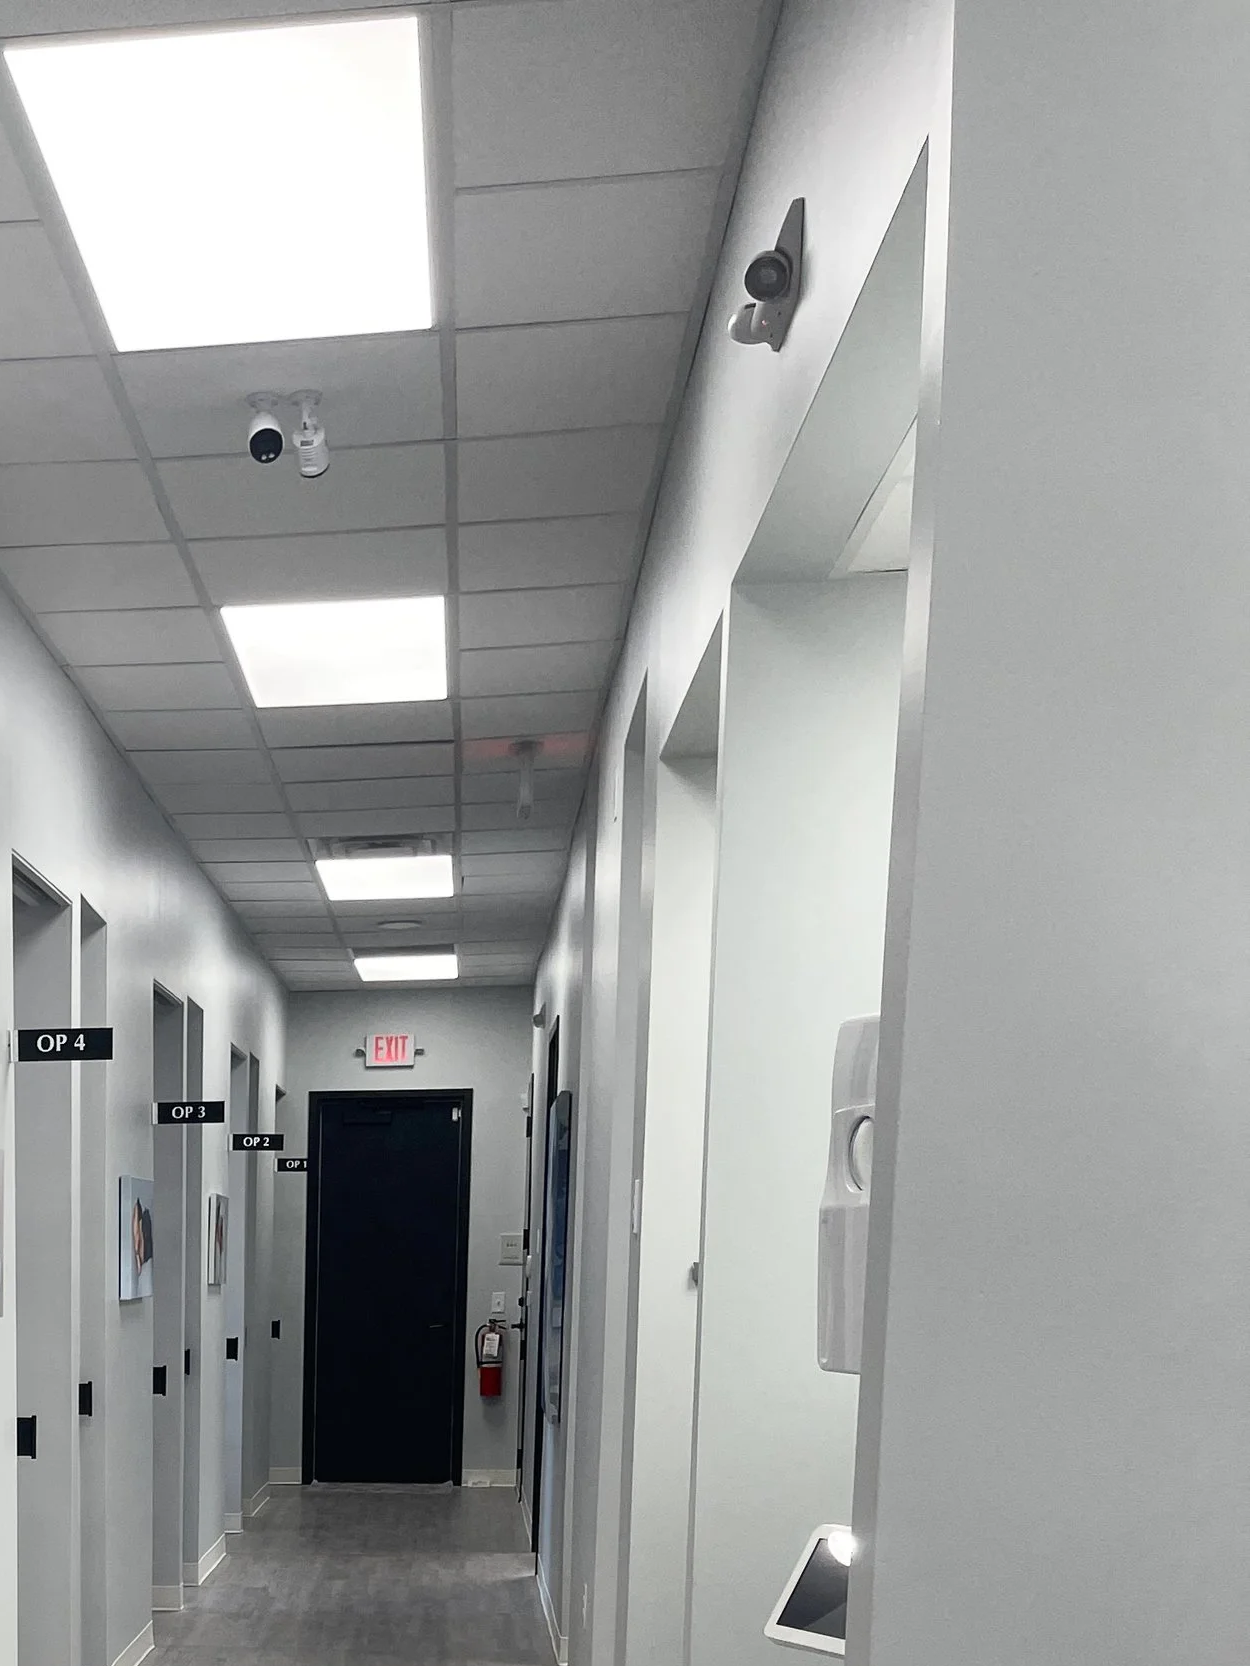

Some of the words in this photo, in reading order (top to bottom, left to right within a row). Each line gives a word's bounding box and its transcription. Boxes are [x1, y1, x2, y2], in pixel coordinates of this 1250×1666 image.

[36, 1034, 68, 1052] OP
[73, 1033, 86, 1051] 4
[374, 1035, 409, 1062] EXIT
[171, 1106, 193, 1119] OP
[197, 1106, 206, 1118] 3
[243, 1136, 260, 1147] OP
[263, 1136, 270, 1147] 2
[286, 1160, 300, 1169] OP
[303, 1160, 307, 1169] 1
